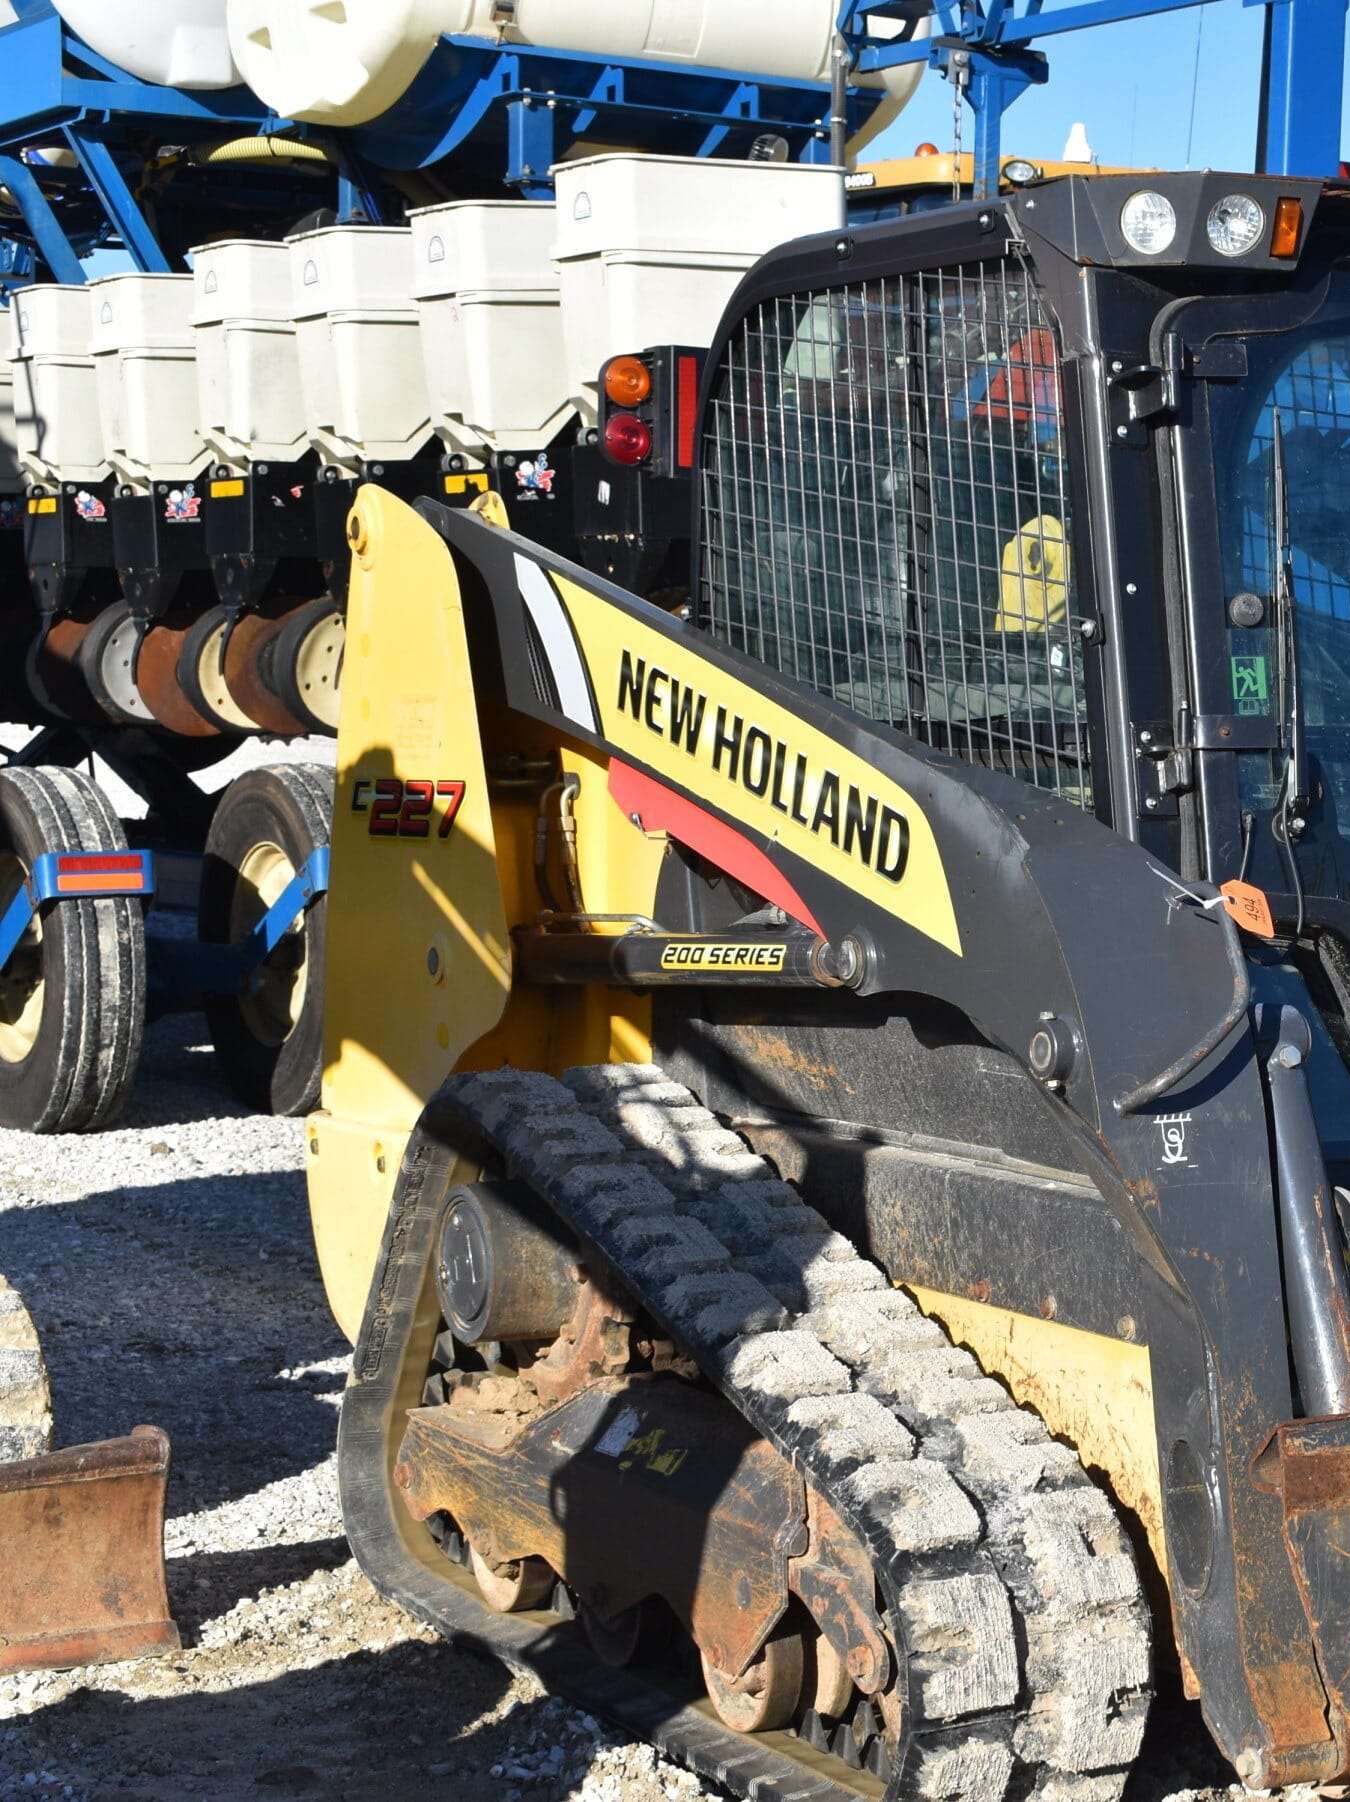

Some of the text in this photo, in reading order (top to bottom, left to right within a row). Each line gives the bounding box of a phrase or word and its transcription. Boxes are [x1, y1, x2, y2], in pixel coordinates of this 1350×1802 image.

[616, 648, 911, 885] NEW HOLLAND
[351, 780, 466, 839] C227
[663, 946, 784, 966] 200 SERIES
